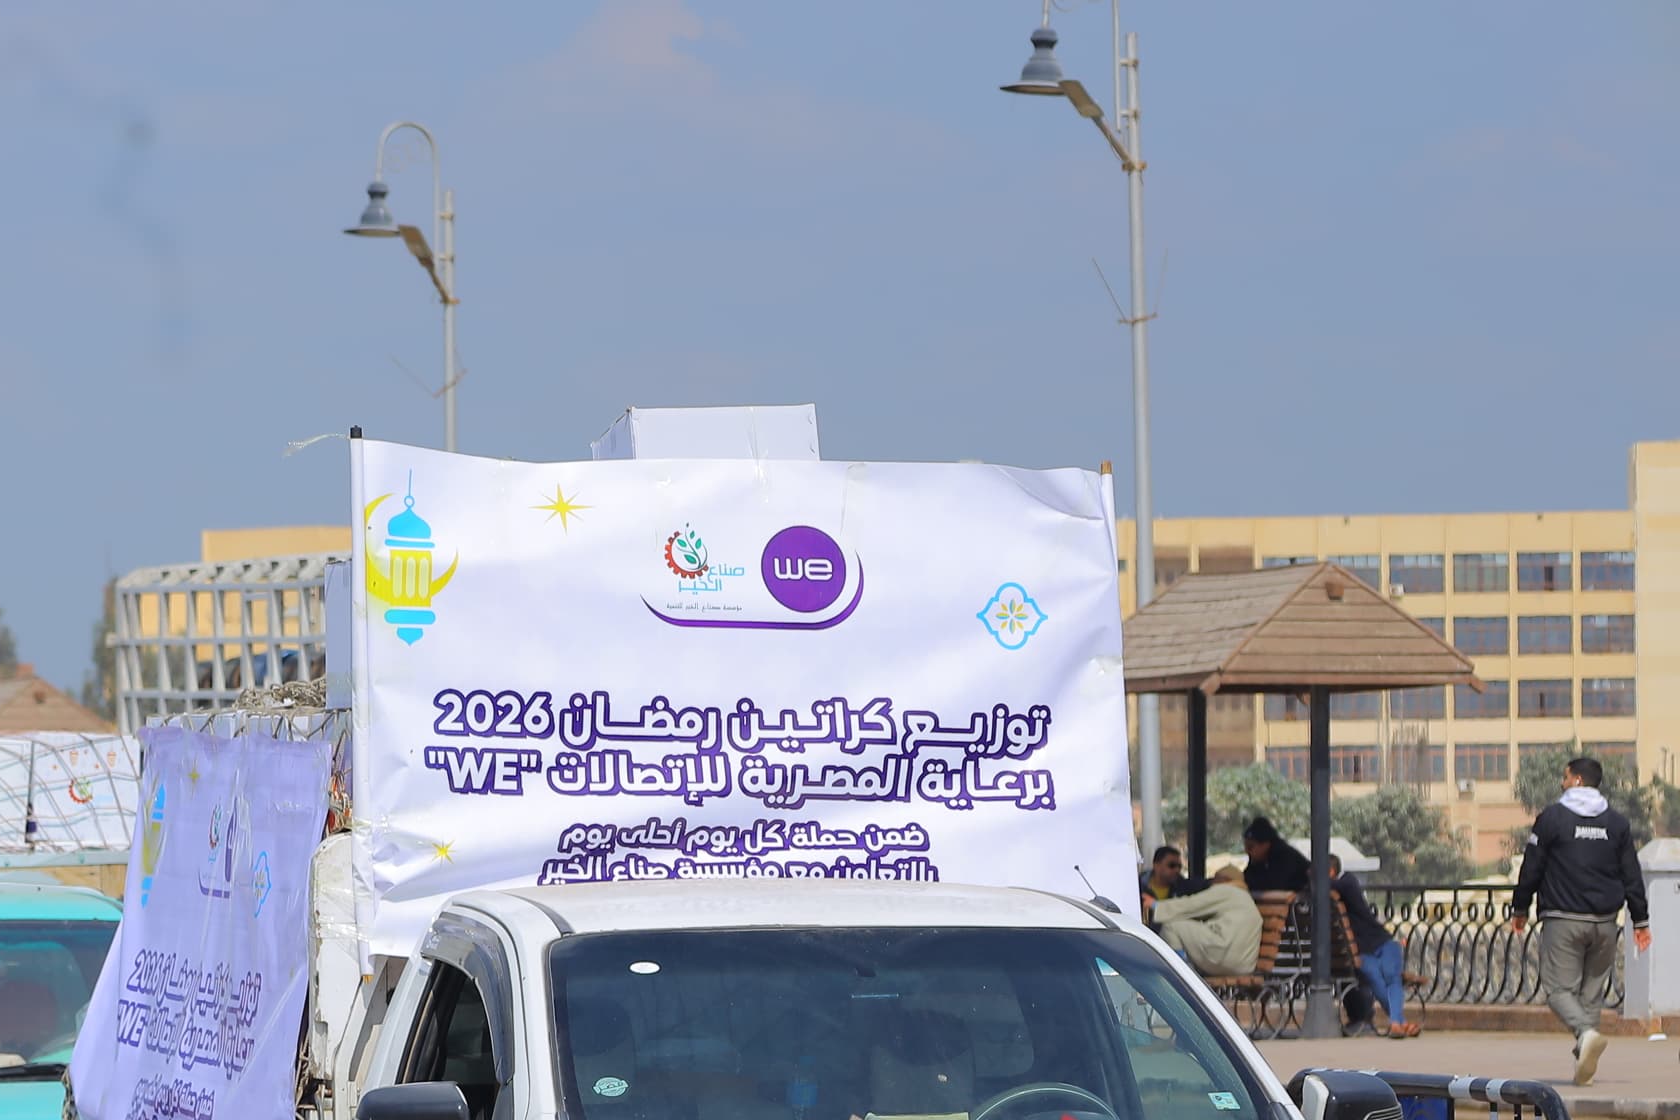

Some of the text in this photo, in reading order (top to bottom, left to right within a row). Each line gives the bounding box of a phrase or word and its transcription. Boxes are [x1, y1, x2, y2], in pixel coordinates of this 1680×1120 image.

[707, 563, 745, 584] صناع
[773, 556, 834, 581] we
[678, 577, 722, 596] الخير
[435, 690, 1050, 758] توزيع كراتين رمضان 2026
[425, 748, 1054, 809] برعاية المصرية للإتصالات "WE"
[558, 817, 929, 856] ضمن حملة كل يوم أحلى يوم
[538, 853, 608, 885] الخير
